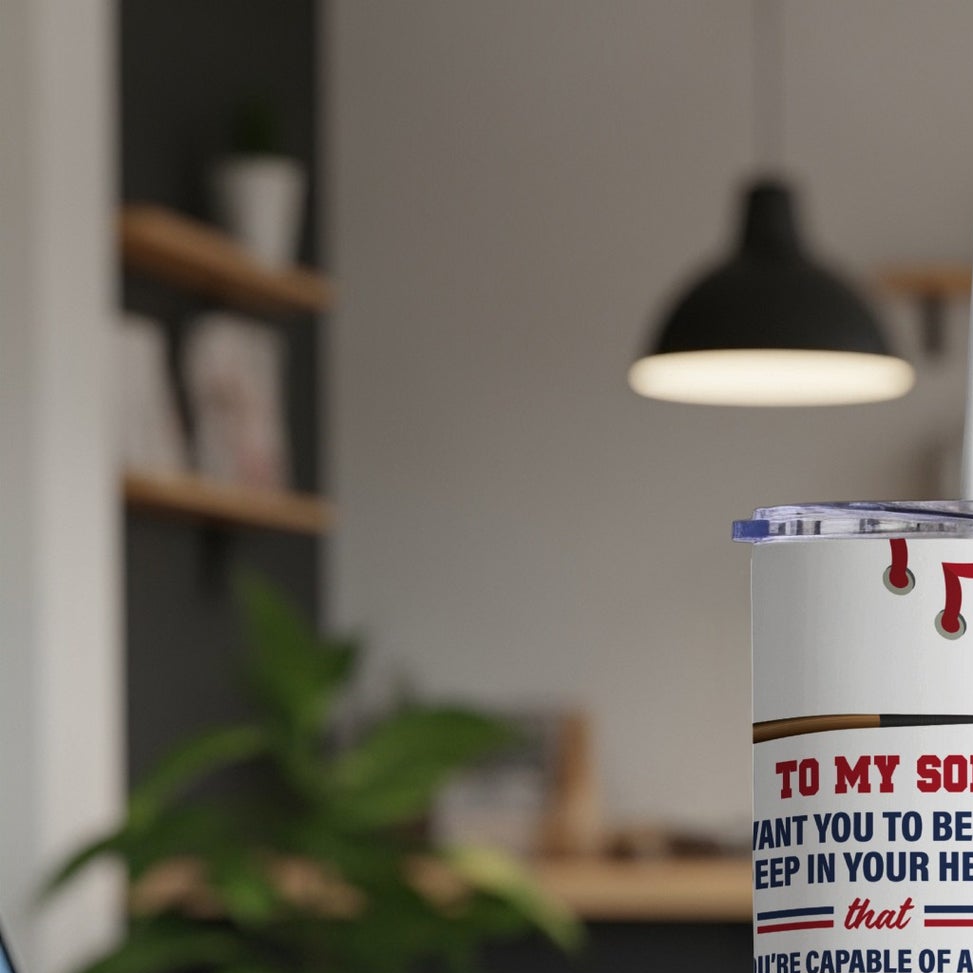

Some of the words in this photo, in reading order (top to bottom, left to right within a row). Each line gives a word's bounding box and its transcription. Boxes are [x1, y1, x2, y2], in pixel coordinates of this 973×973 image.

[776, 758, 819, 799] TO
[834, 755, 900, 794] MY
[753, 815, 808, 851] ANT
[813, 812, 873, 843] YOU
[883, 811, 922, 841] TO
[755, 856, 800, 890] EEP
[808, 853, 835, 884] IN
[843, 852, 928, 882] YOUR
[844, 897, 914, 930] that
[919, 949, 950, 973] OF
